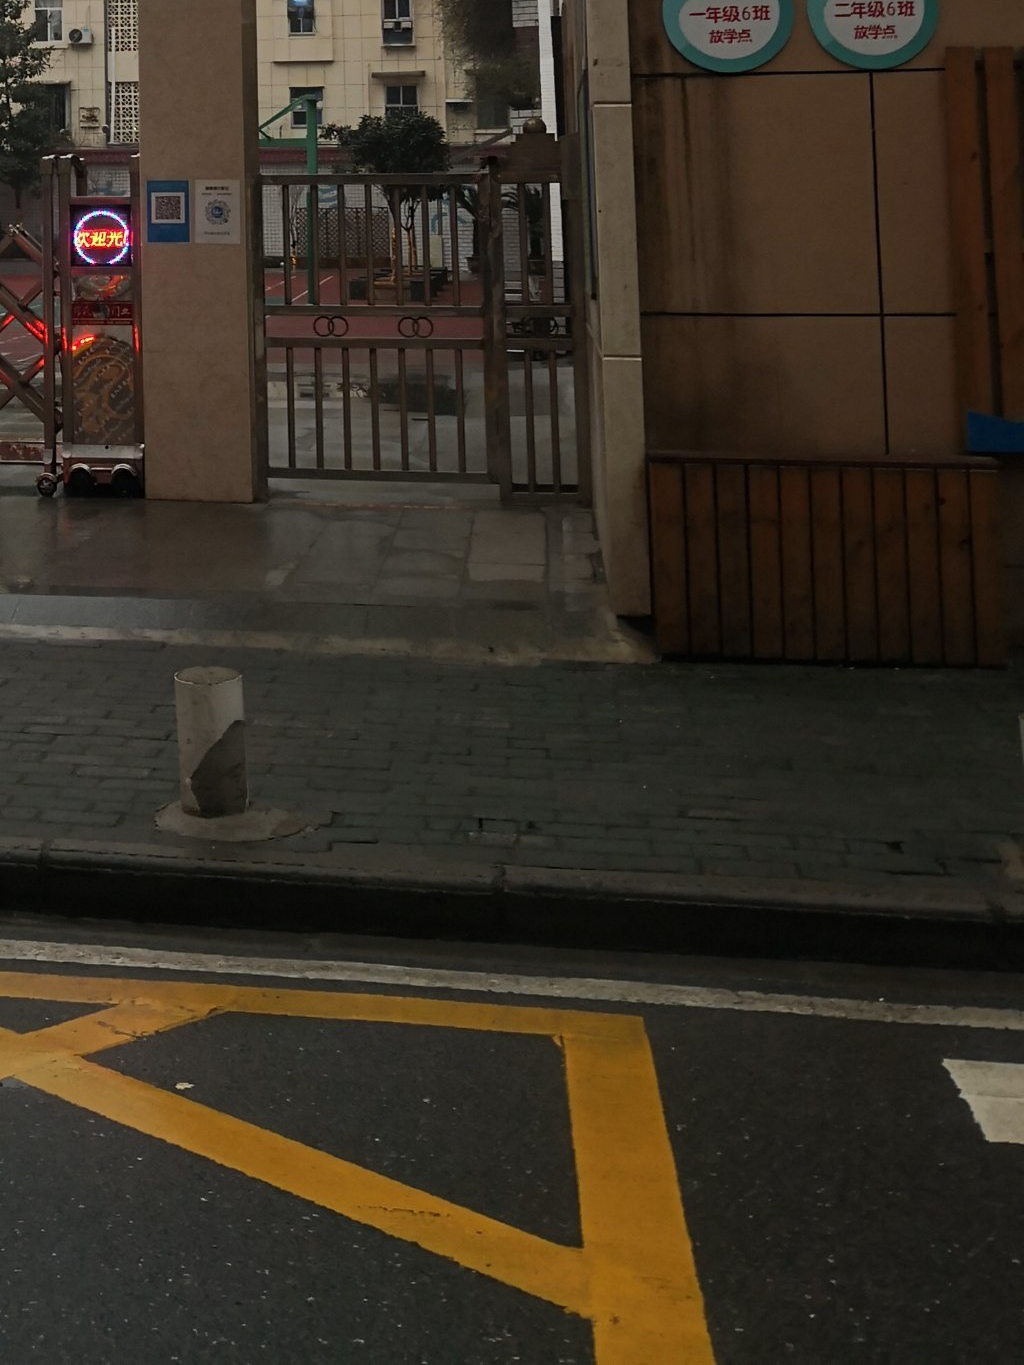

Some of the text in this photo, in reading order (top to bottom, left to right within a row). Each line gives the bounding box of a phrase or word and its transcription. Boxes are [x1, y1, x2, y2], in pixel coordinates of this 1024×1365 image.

[689, 5, 771, 22] 一年级6班
[834, 0, 916, 19] 二年级6班
[708, 28, 753, 45] 放学点
[853, 24, 898, 40] 放学点
